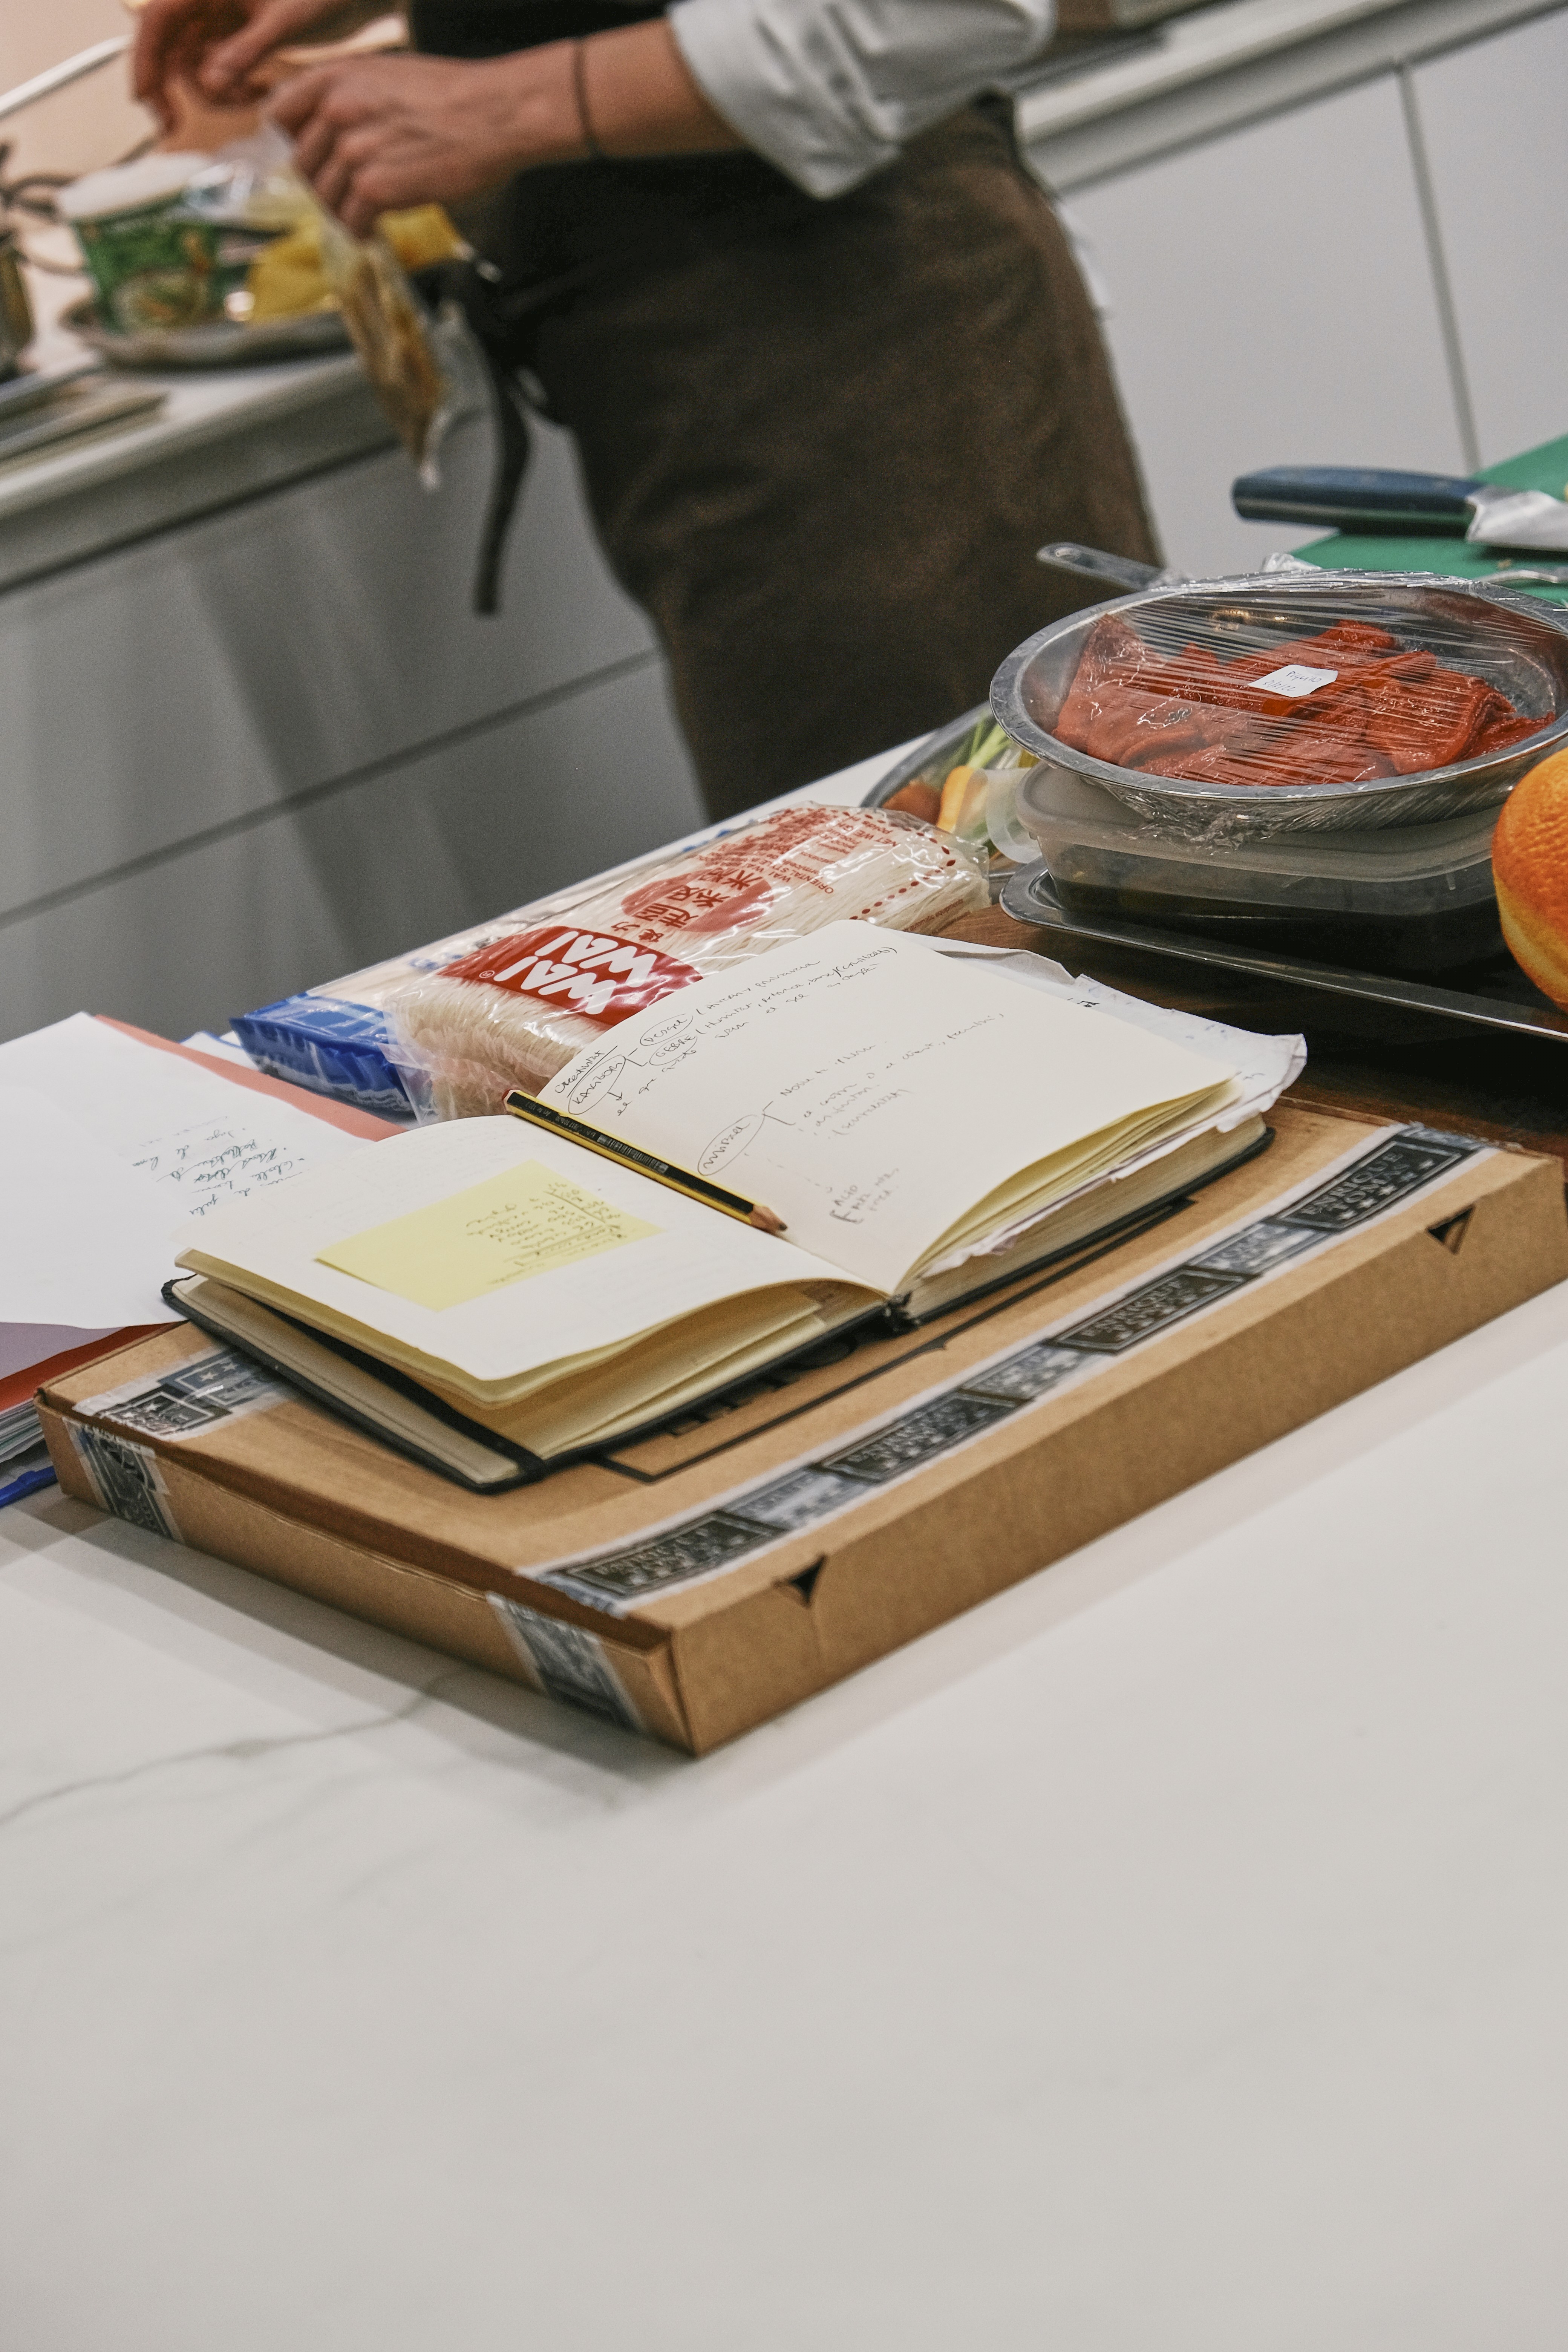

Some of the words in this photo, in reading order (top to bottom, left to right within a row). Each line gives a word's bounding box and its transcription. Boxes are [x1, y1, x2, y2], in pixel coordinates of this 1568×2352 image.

[769, 871, 791, 882] WAI
[790, 871, 834, 894] ORIENTAL
[493, 956, 617, 1015] WAI
[534, 931, 658, 988] WAI
[1300, 1152, 1403, 1214] ENRIQUE
